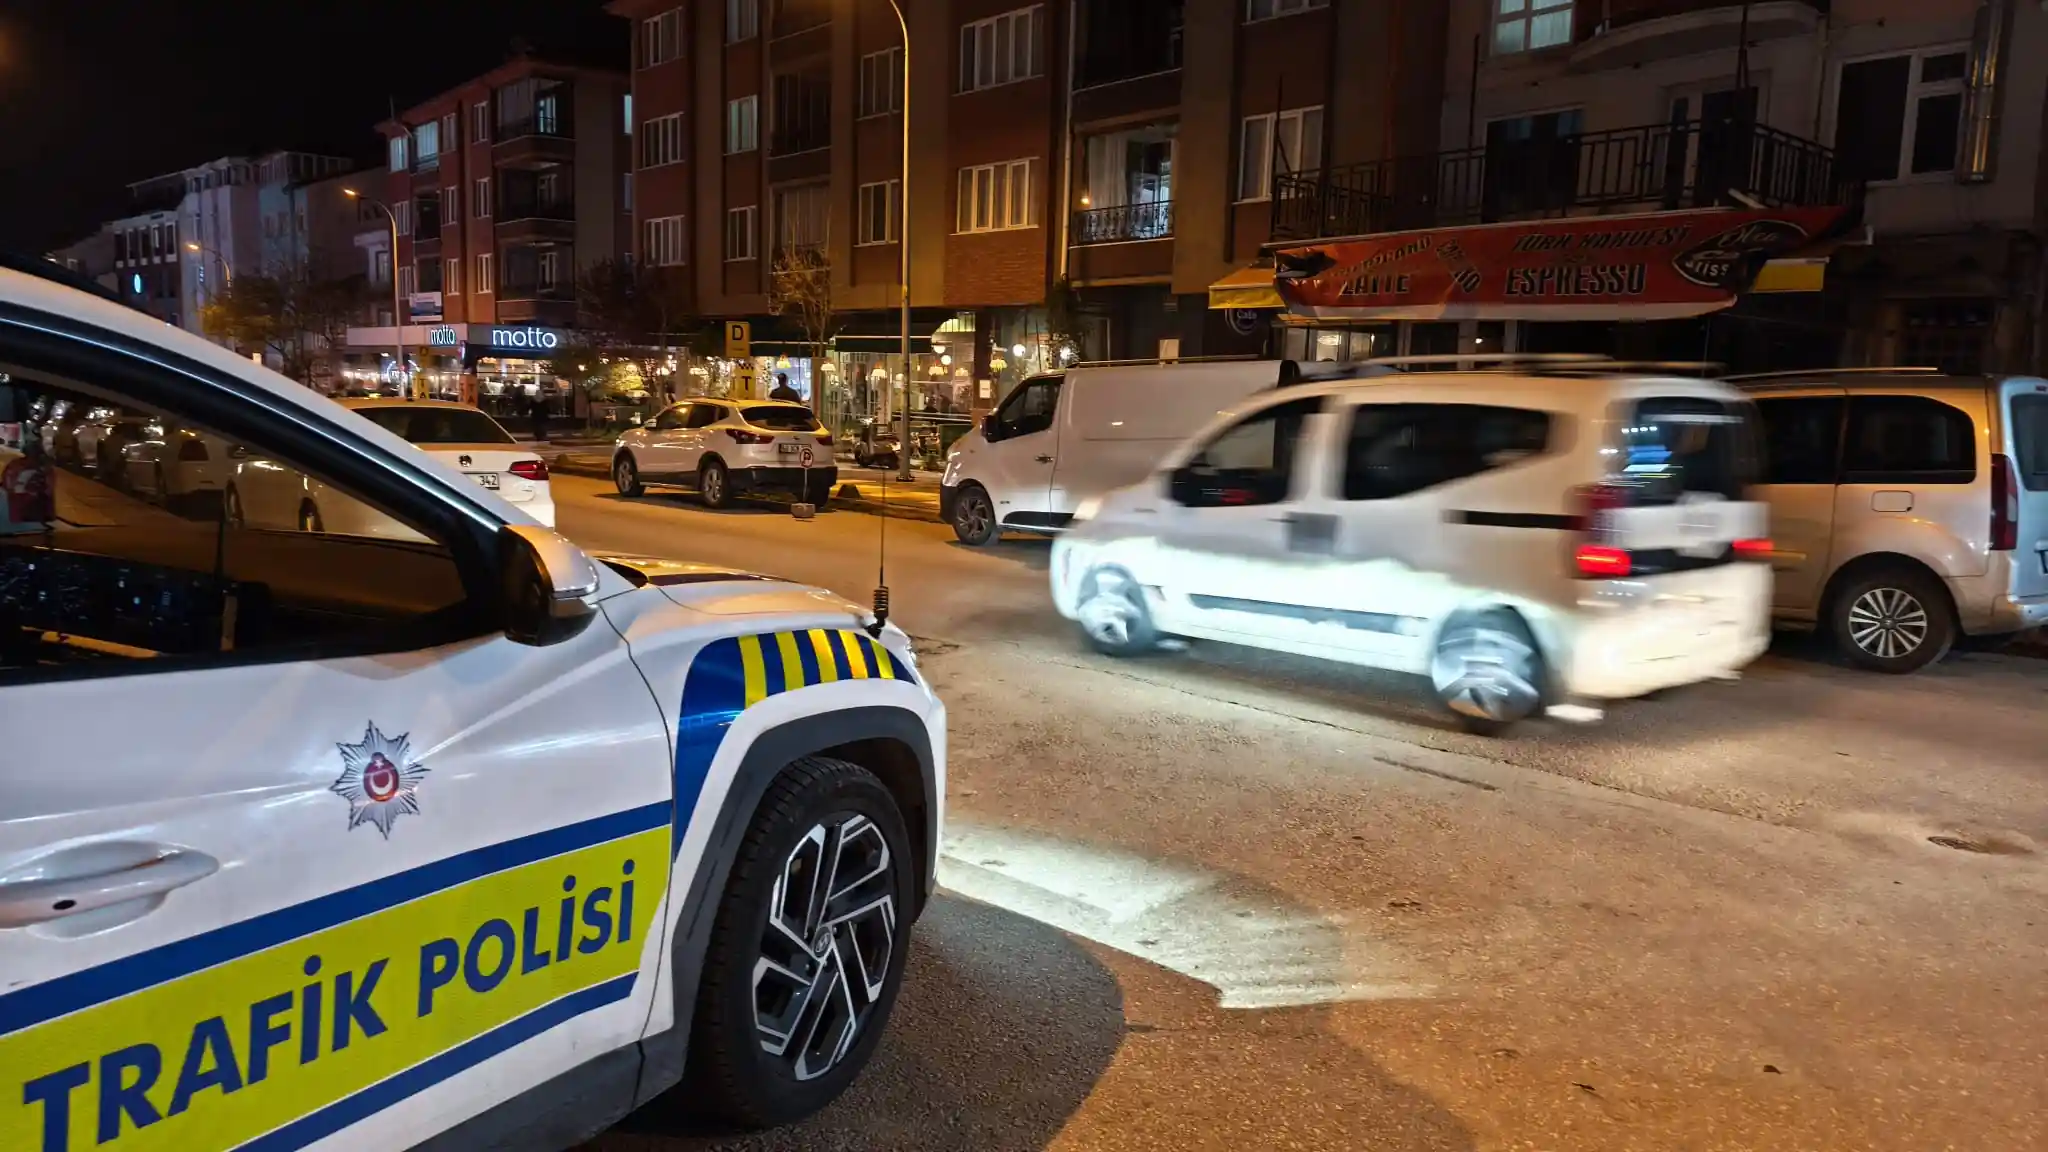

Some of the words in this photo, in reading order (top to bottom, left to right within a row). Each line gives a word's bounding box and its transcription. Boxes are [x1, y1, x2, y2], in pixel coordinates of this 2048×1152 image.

[430, 325, 456, 345] motto
[492, 326, 558, 348] motto
[731, 324, 744, 341] D
[479, 475, 498, 486] 342
[23, 954, 390, 1152] TRAFİK
[417, 858, 637, 1018] POLİSİ
